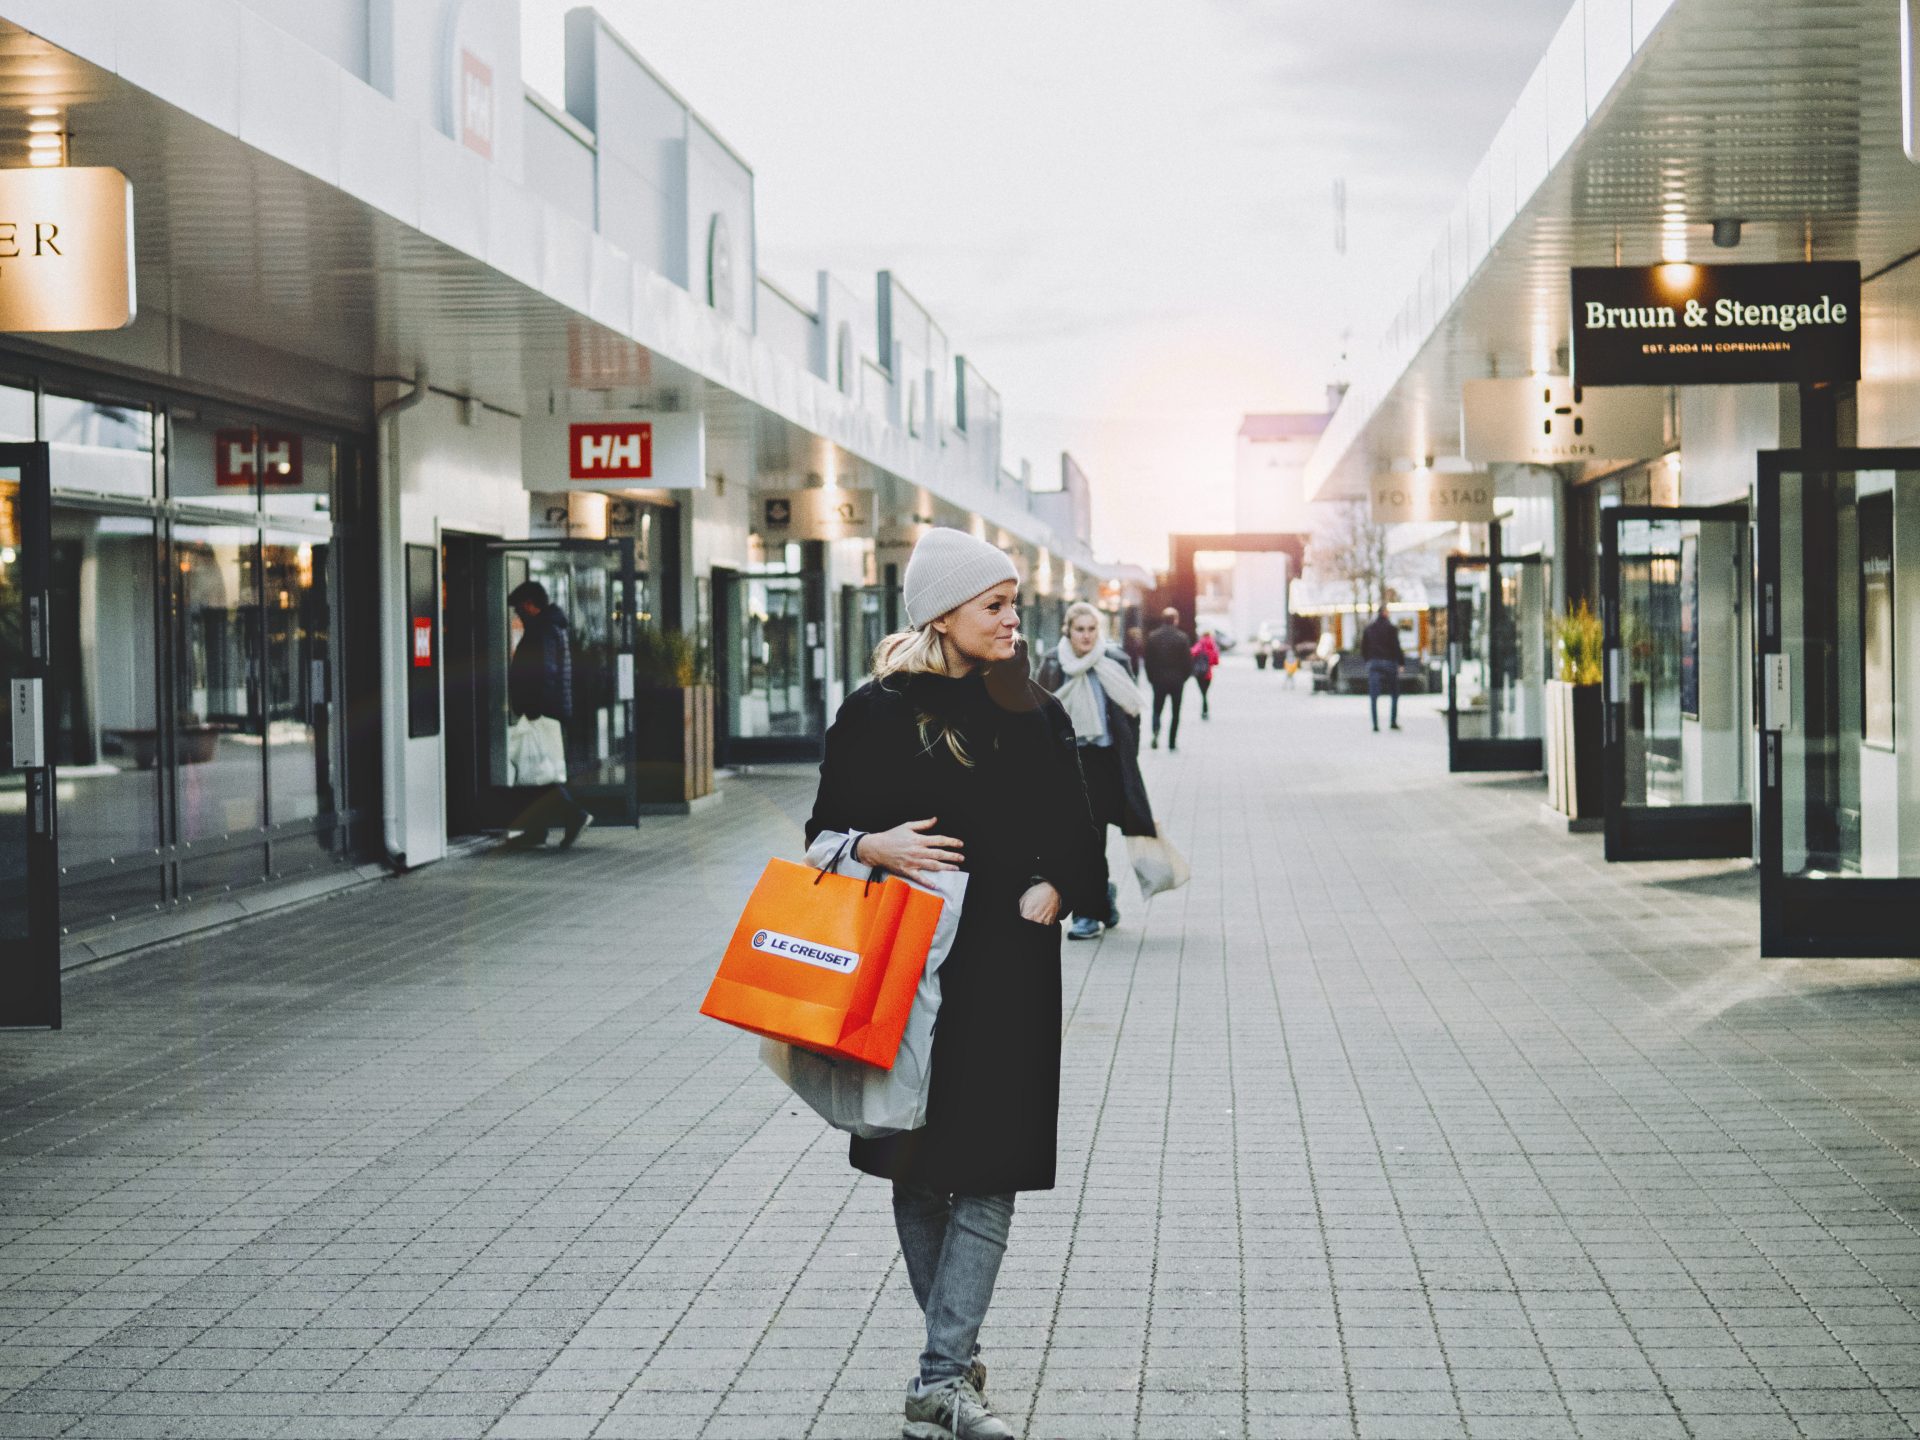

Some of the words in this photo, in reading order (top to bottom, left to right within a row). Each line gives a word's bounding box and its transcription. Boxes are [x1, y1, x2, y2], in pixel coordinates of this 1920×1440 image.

[1585, 301, 1676, 329] Bruun
[1683, 299, 1708, 327] &
[1714, 296, 1847, 331] Stengade
[1642, 343, 1667, 354] EST.
[1669, 343, 1698, 353] 2004
[1701, 343, 1713, 353] IN
[1715, 341, 1791, 353] COPENHAGEN
[1378, 488, 1487, 507] FOESTAD
[770, 938, 788, 951] LE
[789, 943, 852, 967] CREUSET
